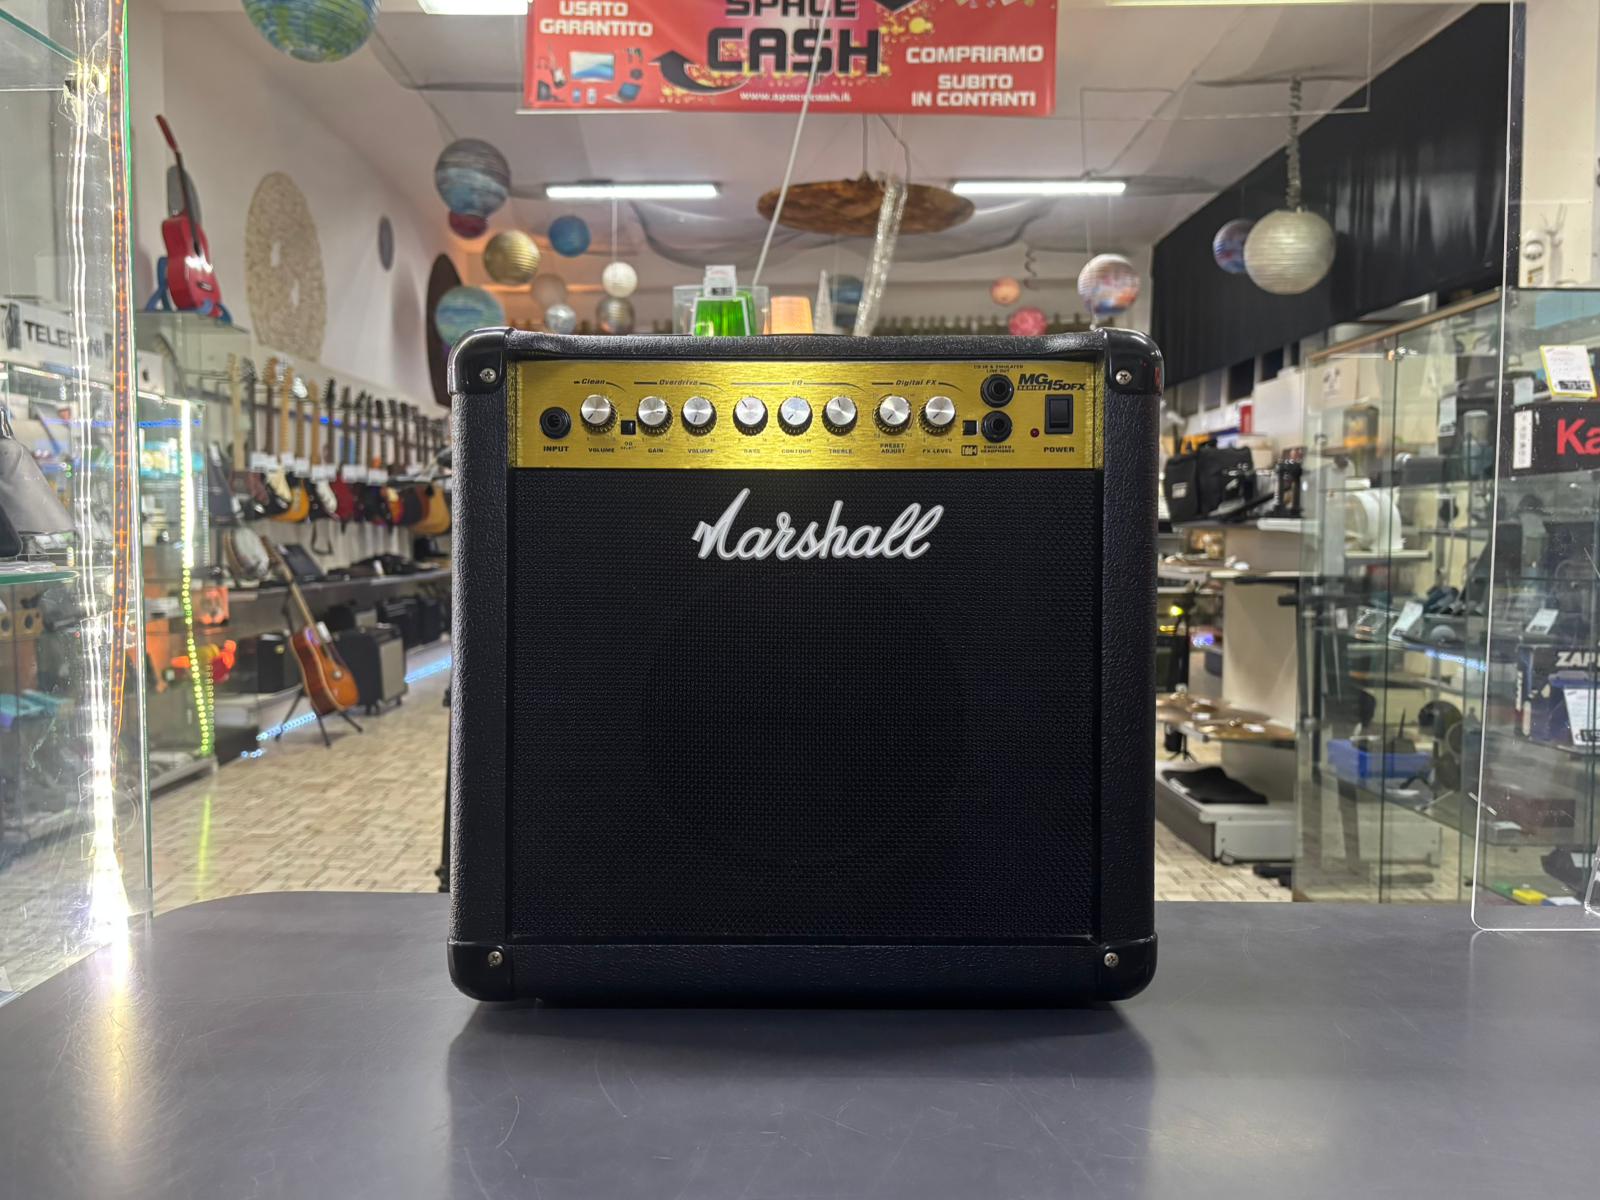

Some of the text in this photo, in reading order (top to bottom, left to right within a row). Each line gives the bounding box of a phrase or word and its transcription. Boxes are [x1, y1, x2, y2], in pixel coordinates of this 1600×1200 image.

[560, 0, 628, 17] USATO
[540, 18, 653, 37] GARANTITO
[708, 28, 880, 74] CASH
[906, 45, 1044, 64] COMPRIAMO
[938, 74, 1013, 90] SUBITO
[911, 91, 1036, 107] IN CONTANTI
[895, 379, 923, 387] Digital
[1018, 373, 1049, 385] MG
[543, 445, 570, 453] INPUT
[691, 487, 944, 560] Marshall
